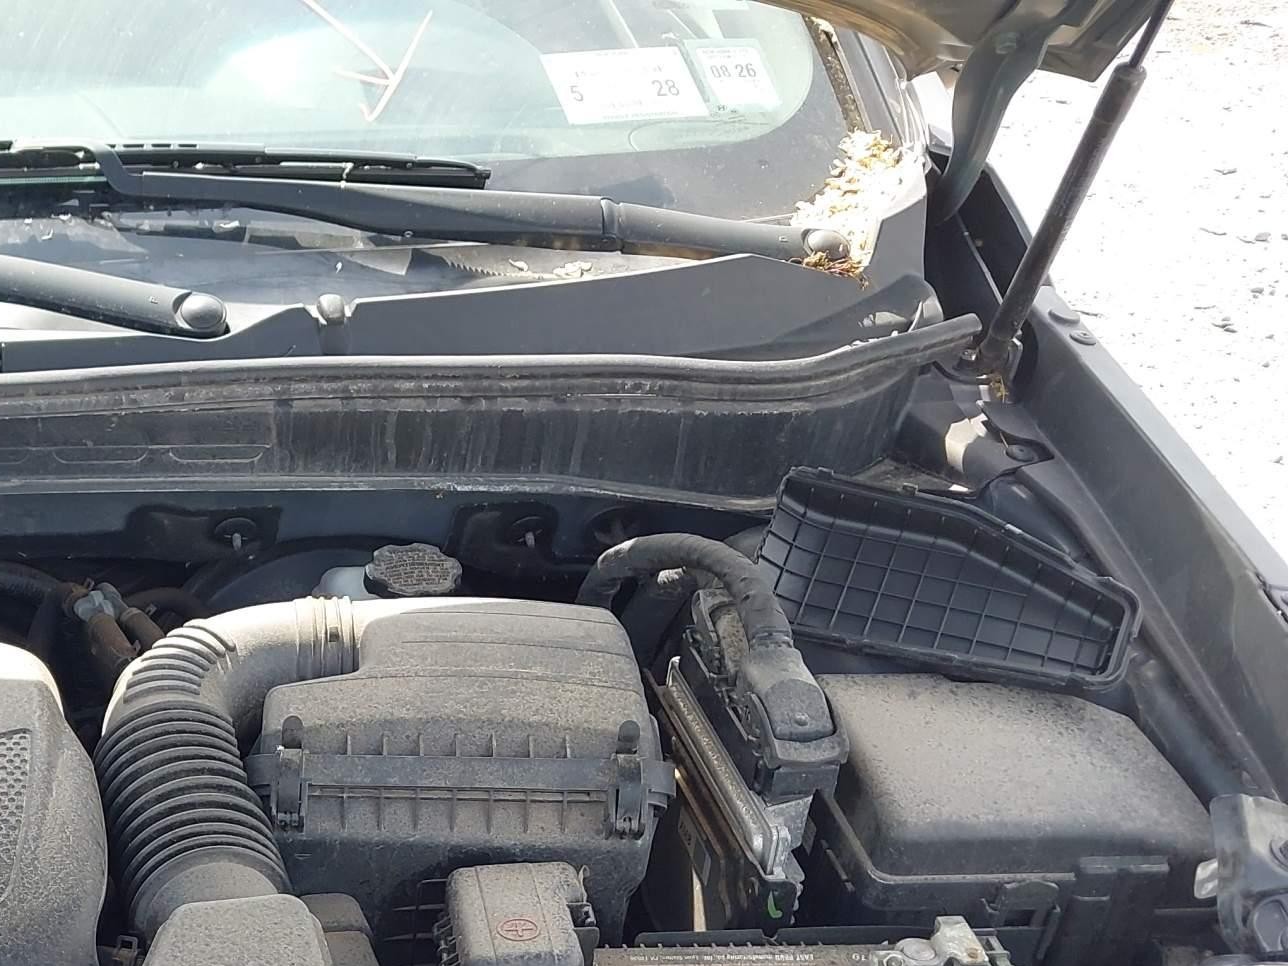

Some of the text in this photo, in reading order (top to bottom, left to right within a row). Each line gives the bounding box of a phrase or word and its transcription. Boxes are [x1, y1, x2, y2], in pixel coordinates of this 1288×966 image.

[710, 62, 758, 80] 08 26
[569, 78, 681, 103] 5 28
